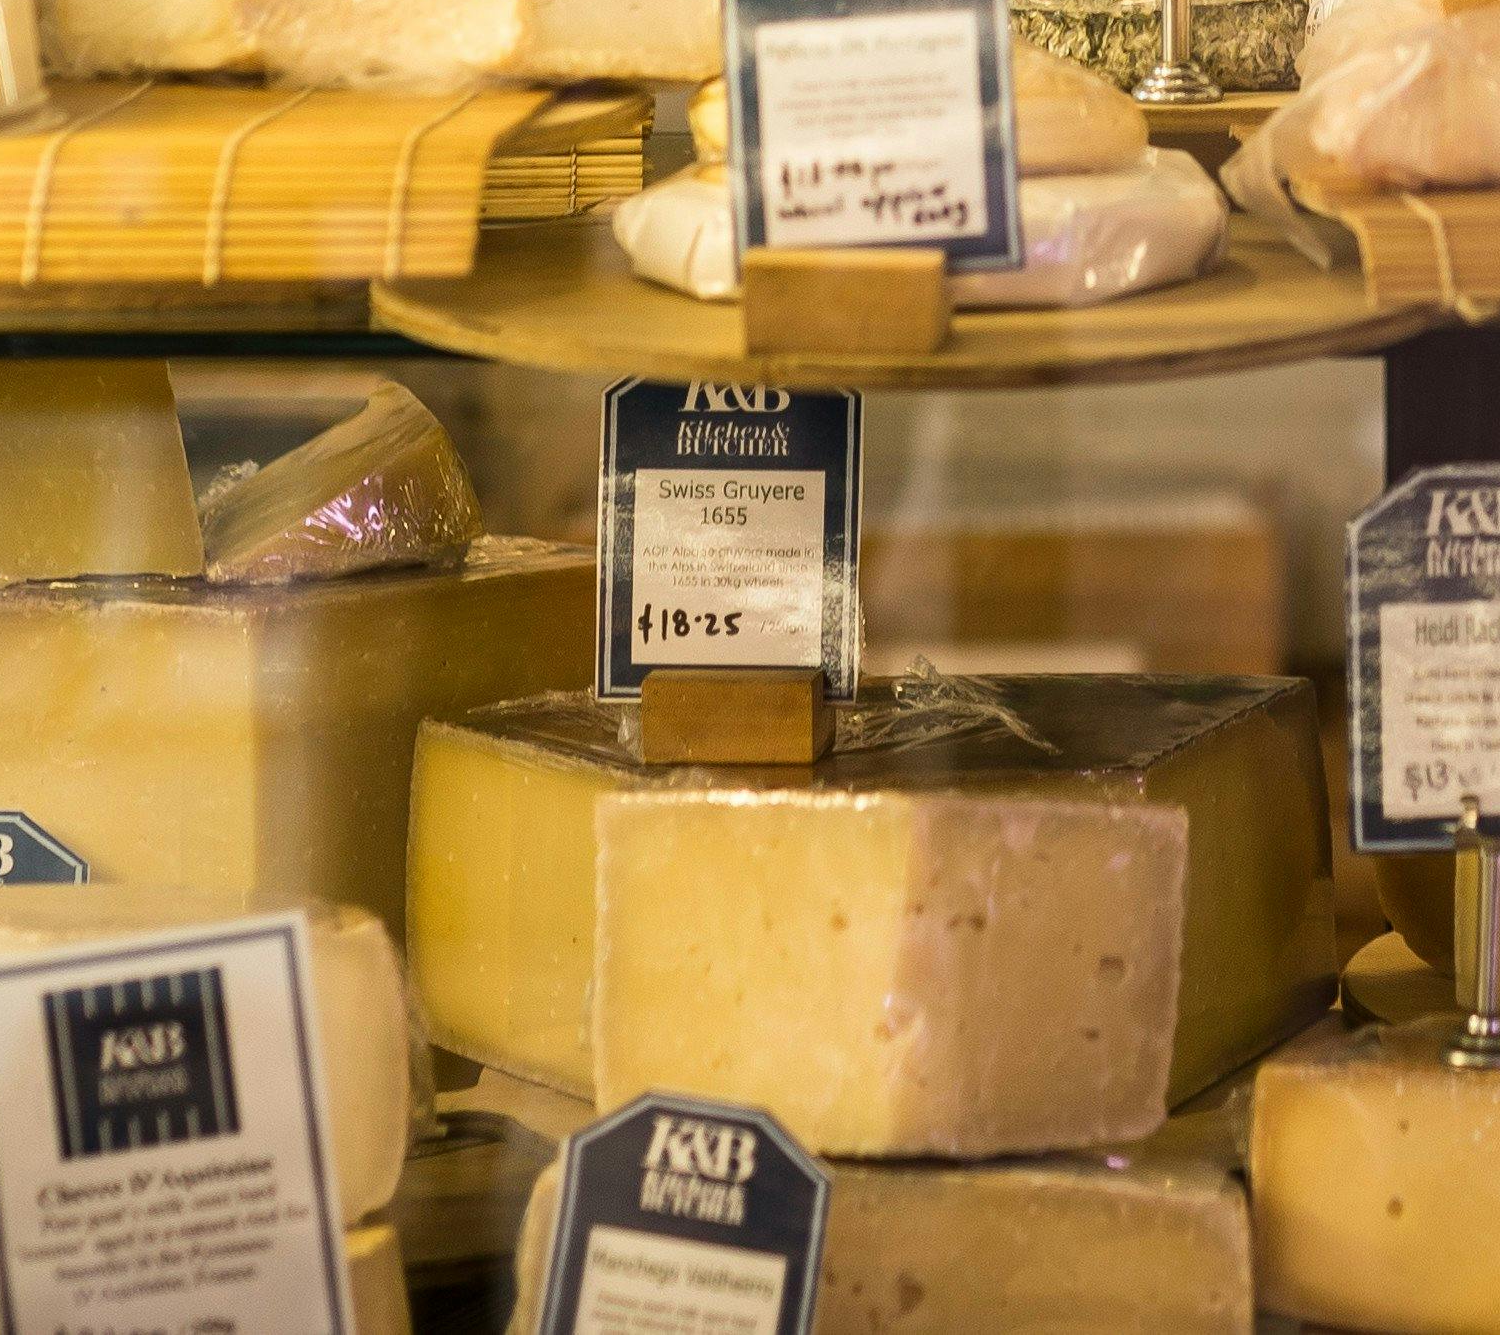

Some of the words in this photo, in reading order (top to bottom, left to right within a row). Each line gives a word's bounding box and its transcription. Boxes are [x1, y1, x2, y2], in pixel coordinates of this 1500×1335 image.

[659, 480, 715, 499] Swiss
[723, 480, 805, 505] Gruyere
[699, 506, 748, 526] 1655
